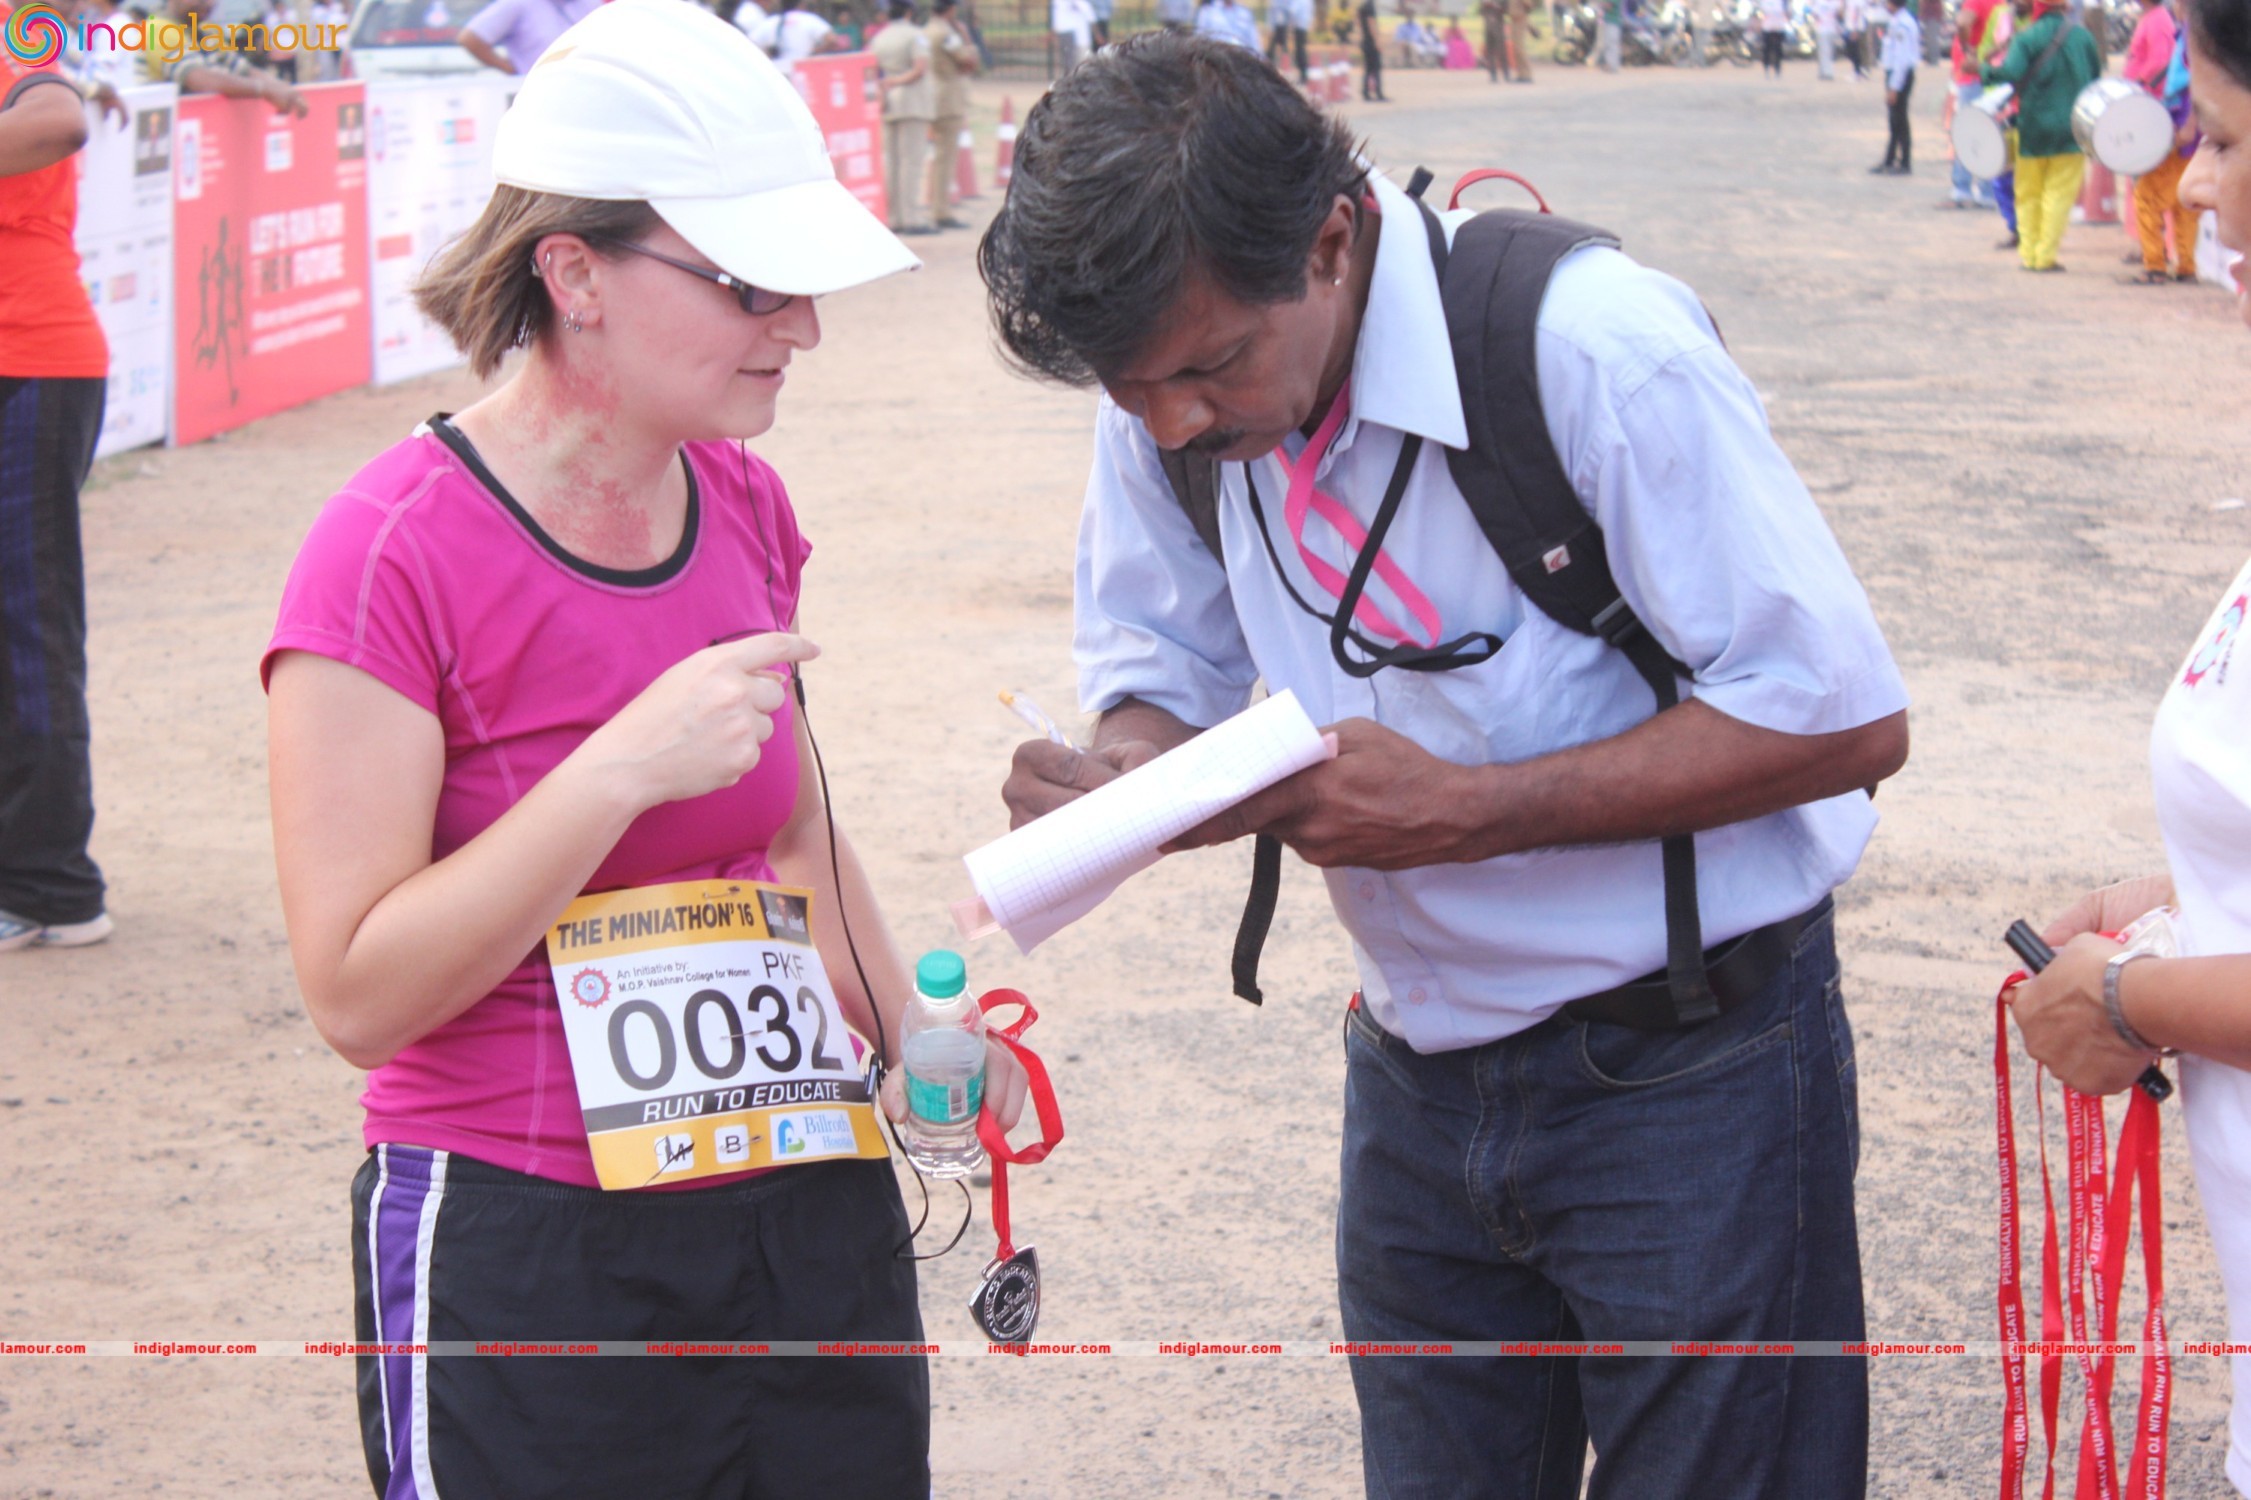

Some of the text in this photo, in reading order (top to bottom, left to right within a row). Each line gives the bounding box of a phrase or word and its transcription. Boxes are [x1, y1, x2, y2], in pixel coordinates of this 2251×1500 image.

[557, 917, 602, 950] THE
[616, 961, 690, 980] An Initiative by:
[618, 967, 752, 992] M.O.P. Vaishnav College for Women
[762, 951, 804, 981] PKF
[607, 983, 844, 1092] 0032
[642, 1081, 842, 1123] RUN TO EDUCATE
[2069, 1088, 2083, 1137] EDUCA
[803, 1113, 850, 1135] Billroth
[724, 1134, 742, 1154] B
[2073, 1139, 2083, 1158] TO
[2000, 1158, 2010, 1184] RUN
[2073, 1160, 2084, 1188] RUN
[2000, 1187, 2012, 1213] RUN
[2074, 1191, 2085, 1219] RUN
[2090, 1193, 2104, 1252] EDUCATE
[2001, 1215, 2013, 1286] PENNKALVI
[2004, 1303, 2021, 1363] EDUCATE
[2010, 1365, 2022, 1383] TO
[2013, 1386, 2024, 1412] RUN
[2152, 1374, 2166, 1404] RUN
[2086, 1397, 2100, 1426] RUN
[2147, 1406, 2163, 1433] RUN
[2013, 1414, 2026, 1442] RUN
[2091, 1429, 2106, 1457] RUN
[2147, 1436, 2161, 1455] TO
[2145, 1457, 2160, 1500] EDUCA
